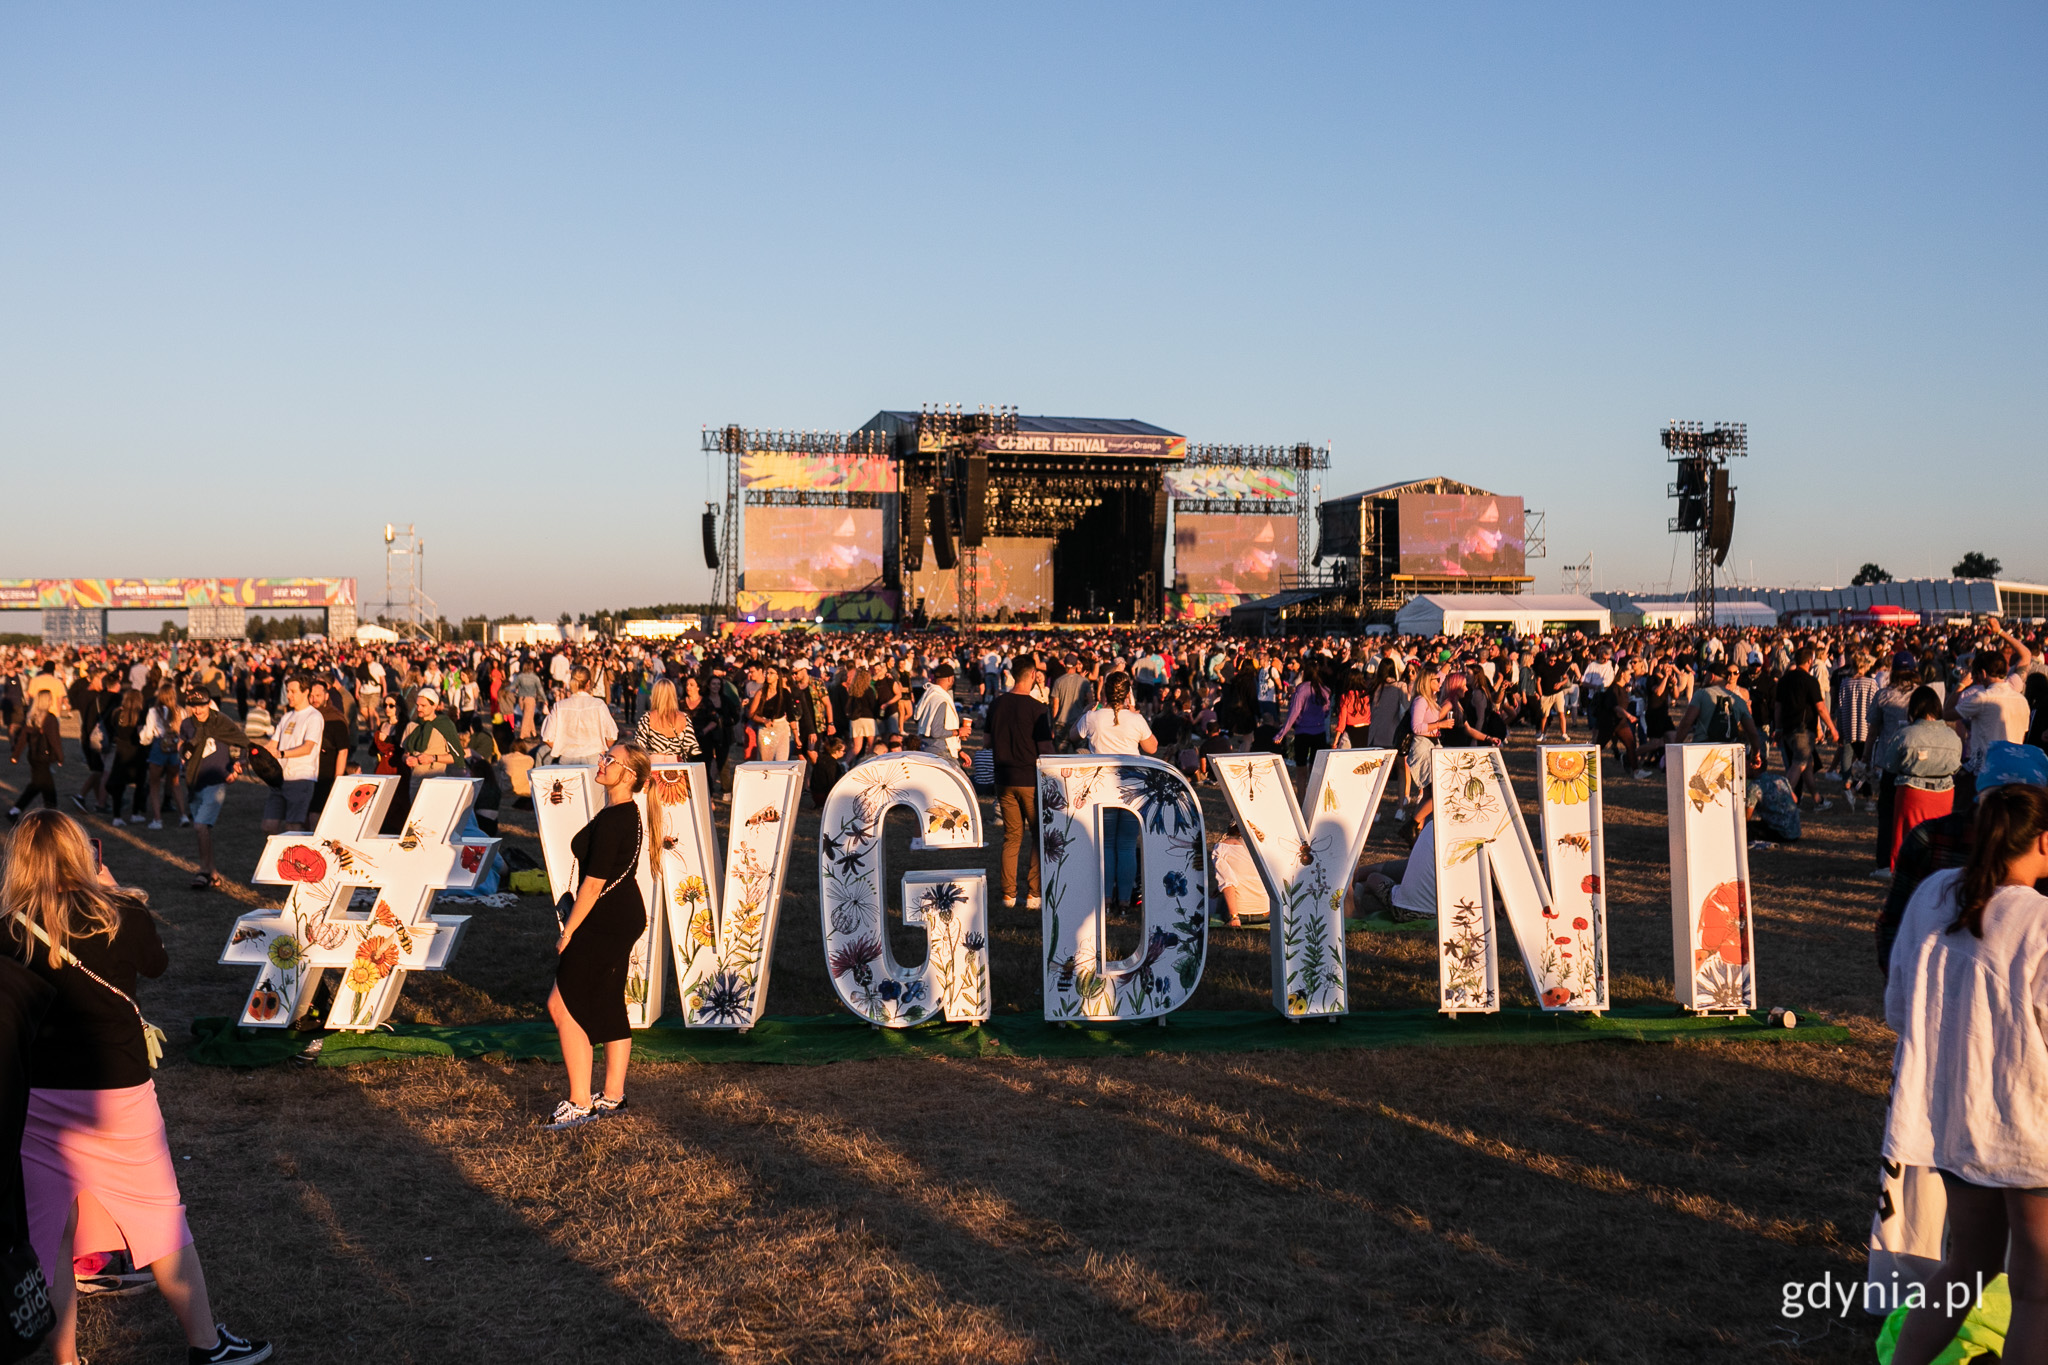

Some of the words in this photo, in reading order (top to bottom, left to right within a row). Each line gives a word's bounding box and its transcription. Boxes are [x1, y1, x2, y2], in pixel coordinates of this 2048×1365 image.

[1053, 437, 1108, 453] FESTIVAL
[1133, 441, 1162, 451] Orange
[272, 588, 289, 597] SEE
[290, 588, 308, 597] YOU
